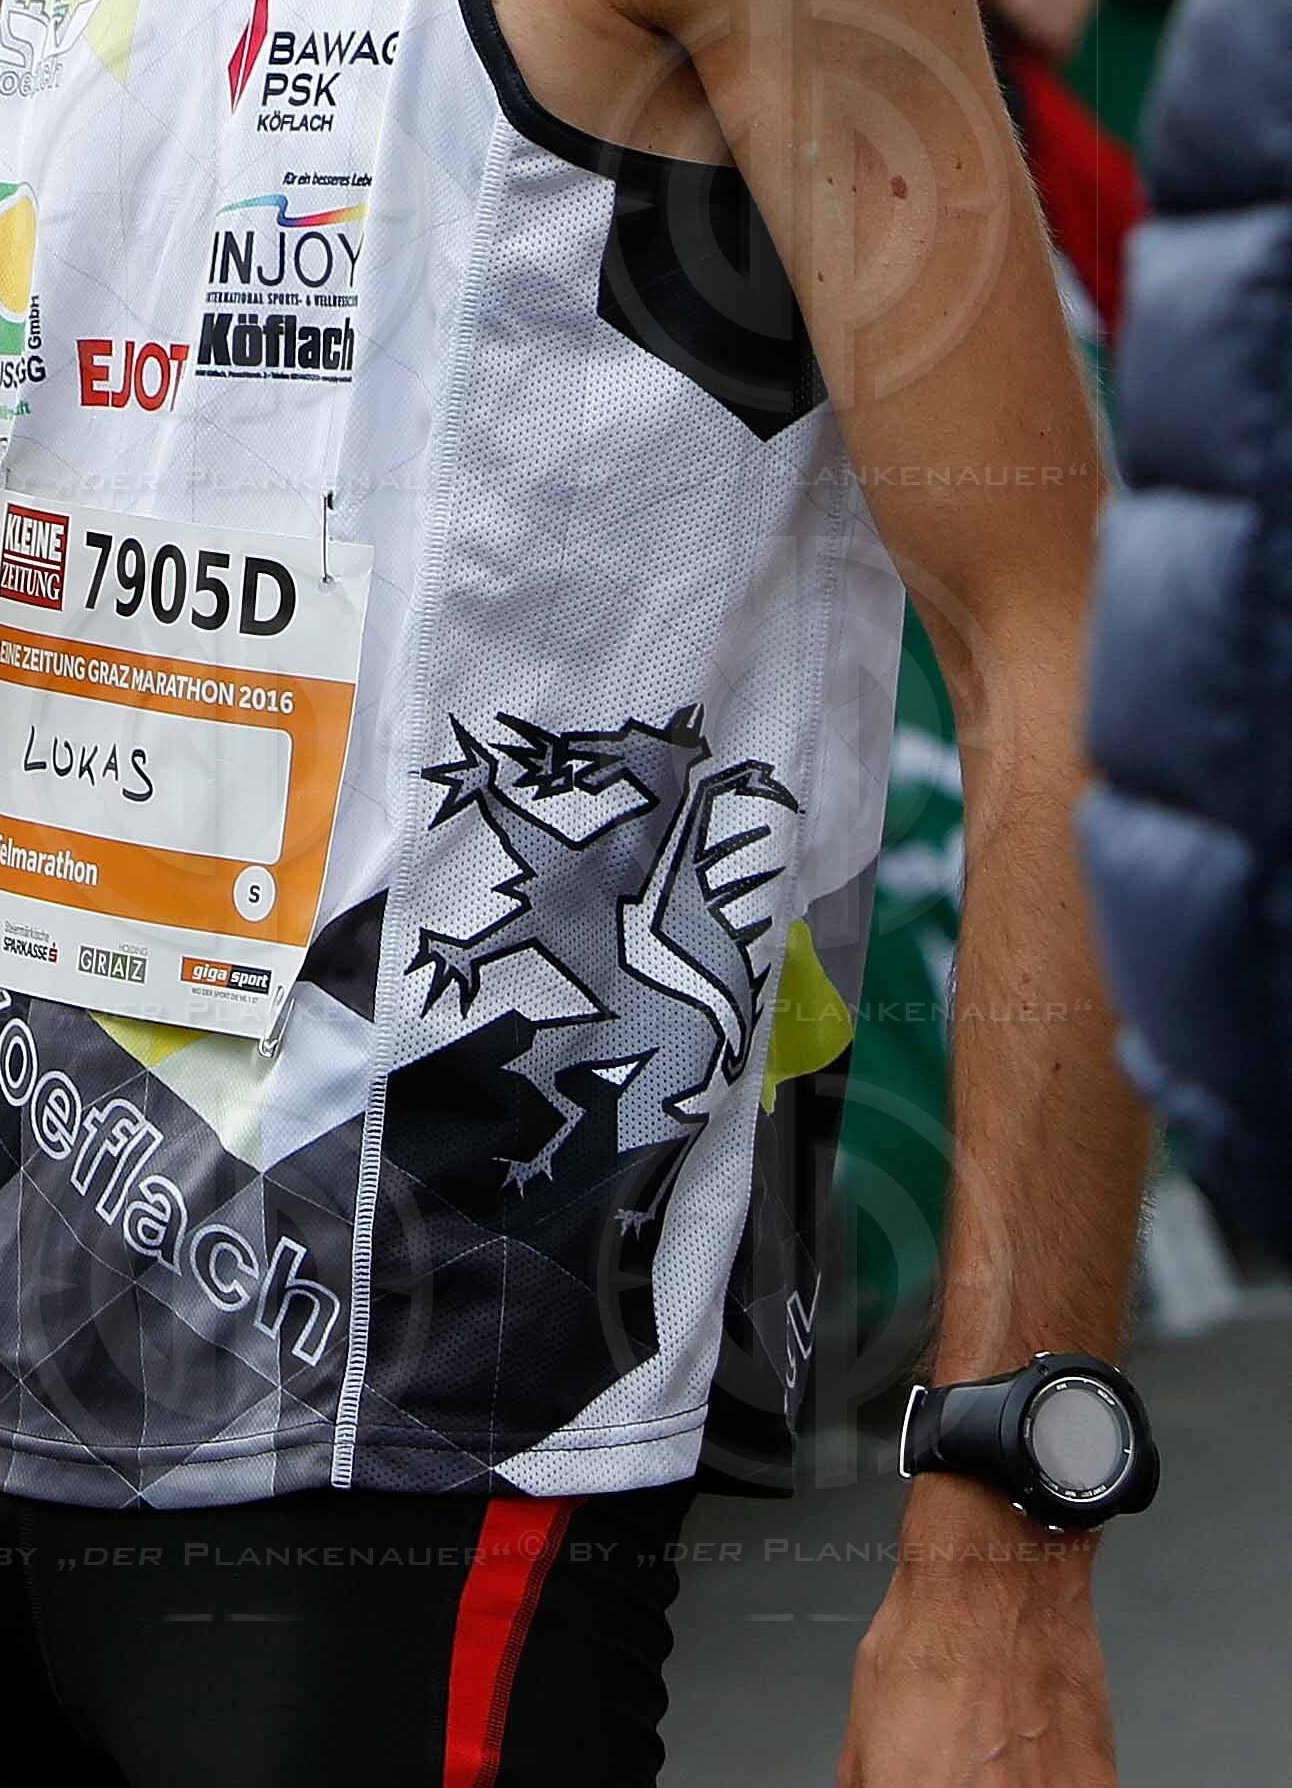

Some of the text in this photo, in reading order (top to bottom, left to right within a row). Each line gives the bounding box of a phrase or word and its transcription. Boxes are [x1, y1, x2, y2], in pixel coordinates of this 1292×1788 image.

[261, 73, 339, 107] PSK
[257, 111, 334, 133] KÖFLACH
[208, 231, 365, 288] INJOY
[196, 312, 355, 371] Köflach
[76, 338, 191, 413] EJOT
[4, 513, 66, 563] KLEINE
[0, 561, 62, 602] ZEITUNG
[84, 530, 297, 637] 7905D
[21, 645, 86, 680] ZEITUNG
[87, 659, 130, 689] GRAZ
[130, 668, 235, 707] MARATHON
[238, 685, 295, 714] 2016
[23, 724, 154, 802] LUKAS
[248, 883, 262, 904] S
[2, 936, 48, 962] SPARKASSE
[79, 946, 146, 982] GRAZ
[191, 962, 269, 990] giga sport
